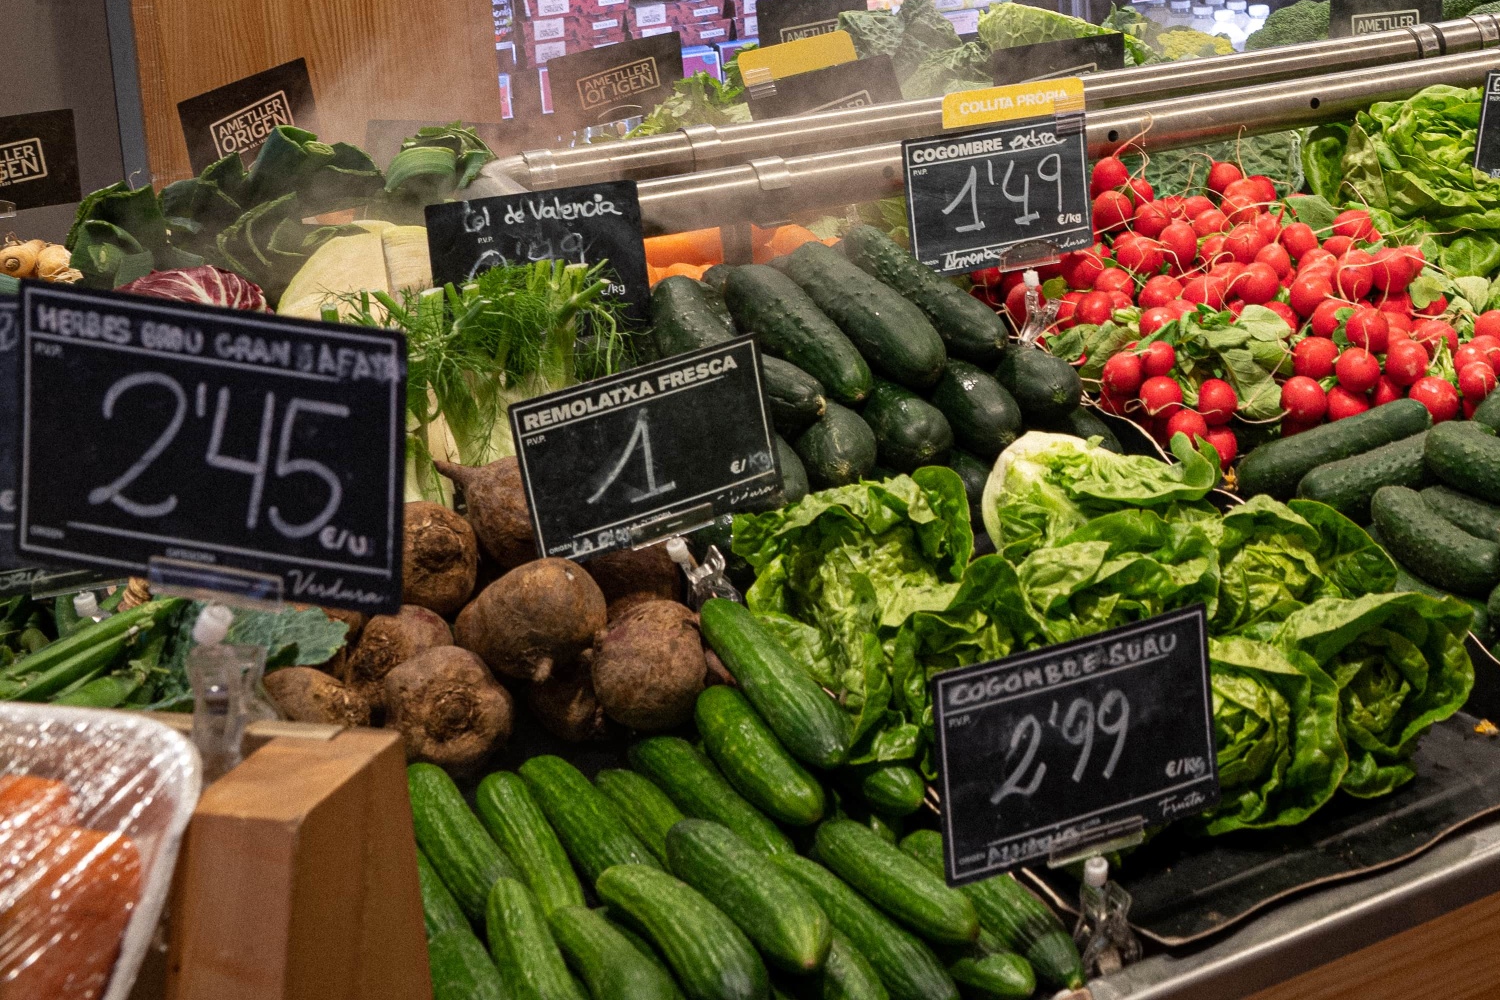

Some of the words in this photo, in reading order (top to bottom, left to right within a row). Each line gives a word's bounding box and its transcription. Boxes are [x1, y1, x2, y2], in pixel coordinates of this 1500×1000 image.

[1357, 14, 1415, 34] AMETLLER
[585, 62, 650, 92] AMETLLER
[219, 98, 284, 139] AMETLLER
[959, 93, 1014, 116] COLLITA
[1015, 87, 1069, 108] PRÒPIA
[222, 109, 289, 153] ORIGEN
[912, 136, 1003, 164] COGOMBRE
[504, 203, 525, 225] de
[528, 193, 623, 221] Valencia
[941, 153, 1063, 233] 1'49
[1056, 211, 1082, 227] €/kg
[36, 303, 131, 346] HERBES
[214, 331, 291, 367] GRAN
[523, 378, 656, 431] REMOLATXA
[657, 354, 738, 393] FRESCA
[88, 371, 351, 538] 2'45
[587, 408, 677, 504] 1
[950, 655, 1101, 705] COGOMBRE
[1107, 632, 1177, 667] SUAU
[990, 688, 1131, 806] 2'99
